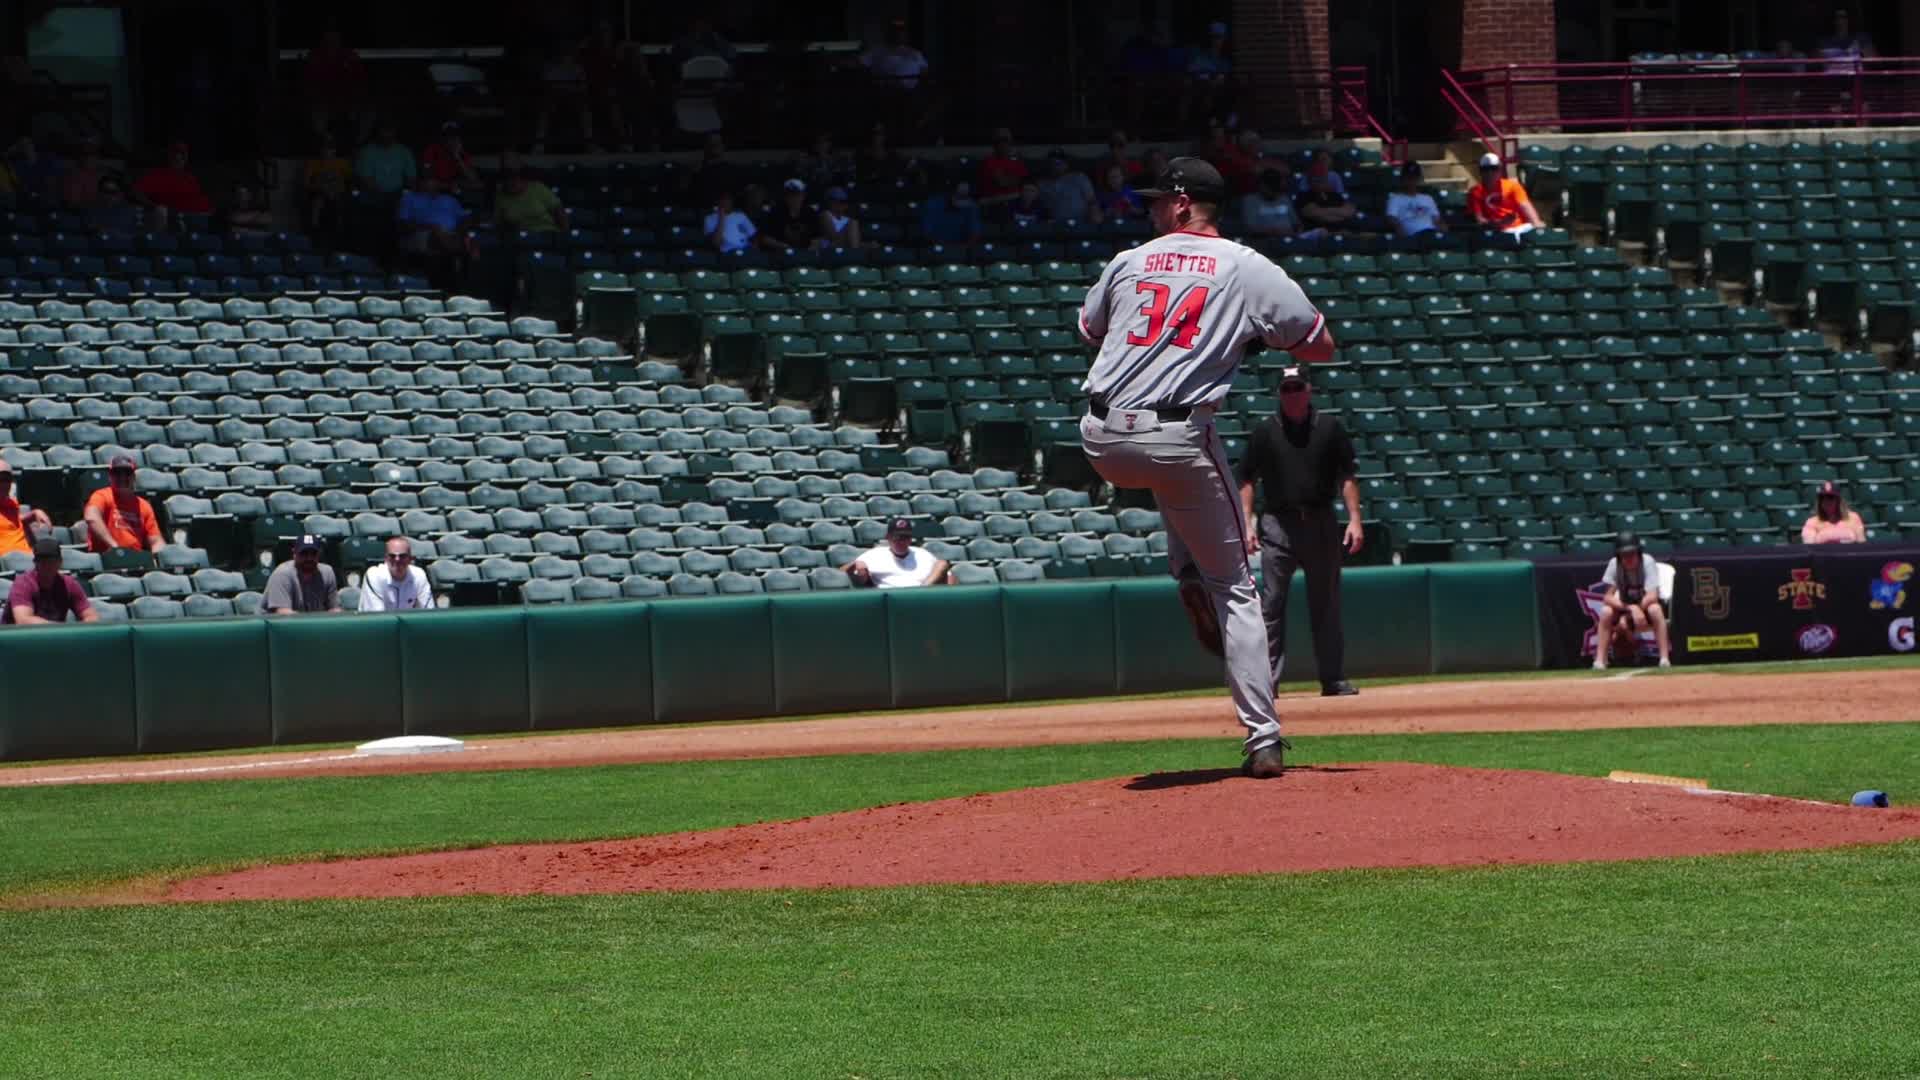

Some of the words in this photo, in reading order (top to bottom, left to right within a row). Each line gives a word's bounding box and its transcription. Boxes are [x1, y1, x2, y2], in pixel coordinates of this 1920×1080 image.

[1144, 252, 1217, 276] SHETTER
[1126, 280, 1209, 350] 34
[1690, 567, 1730, 619] BU
[1778, 581, 1826, 601] STATE
[1888, 616, 1915, 651] G
